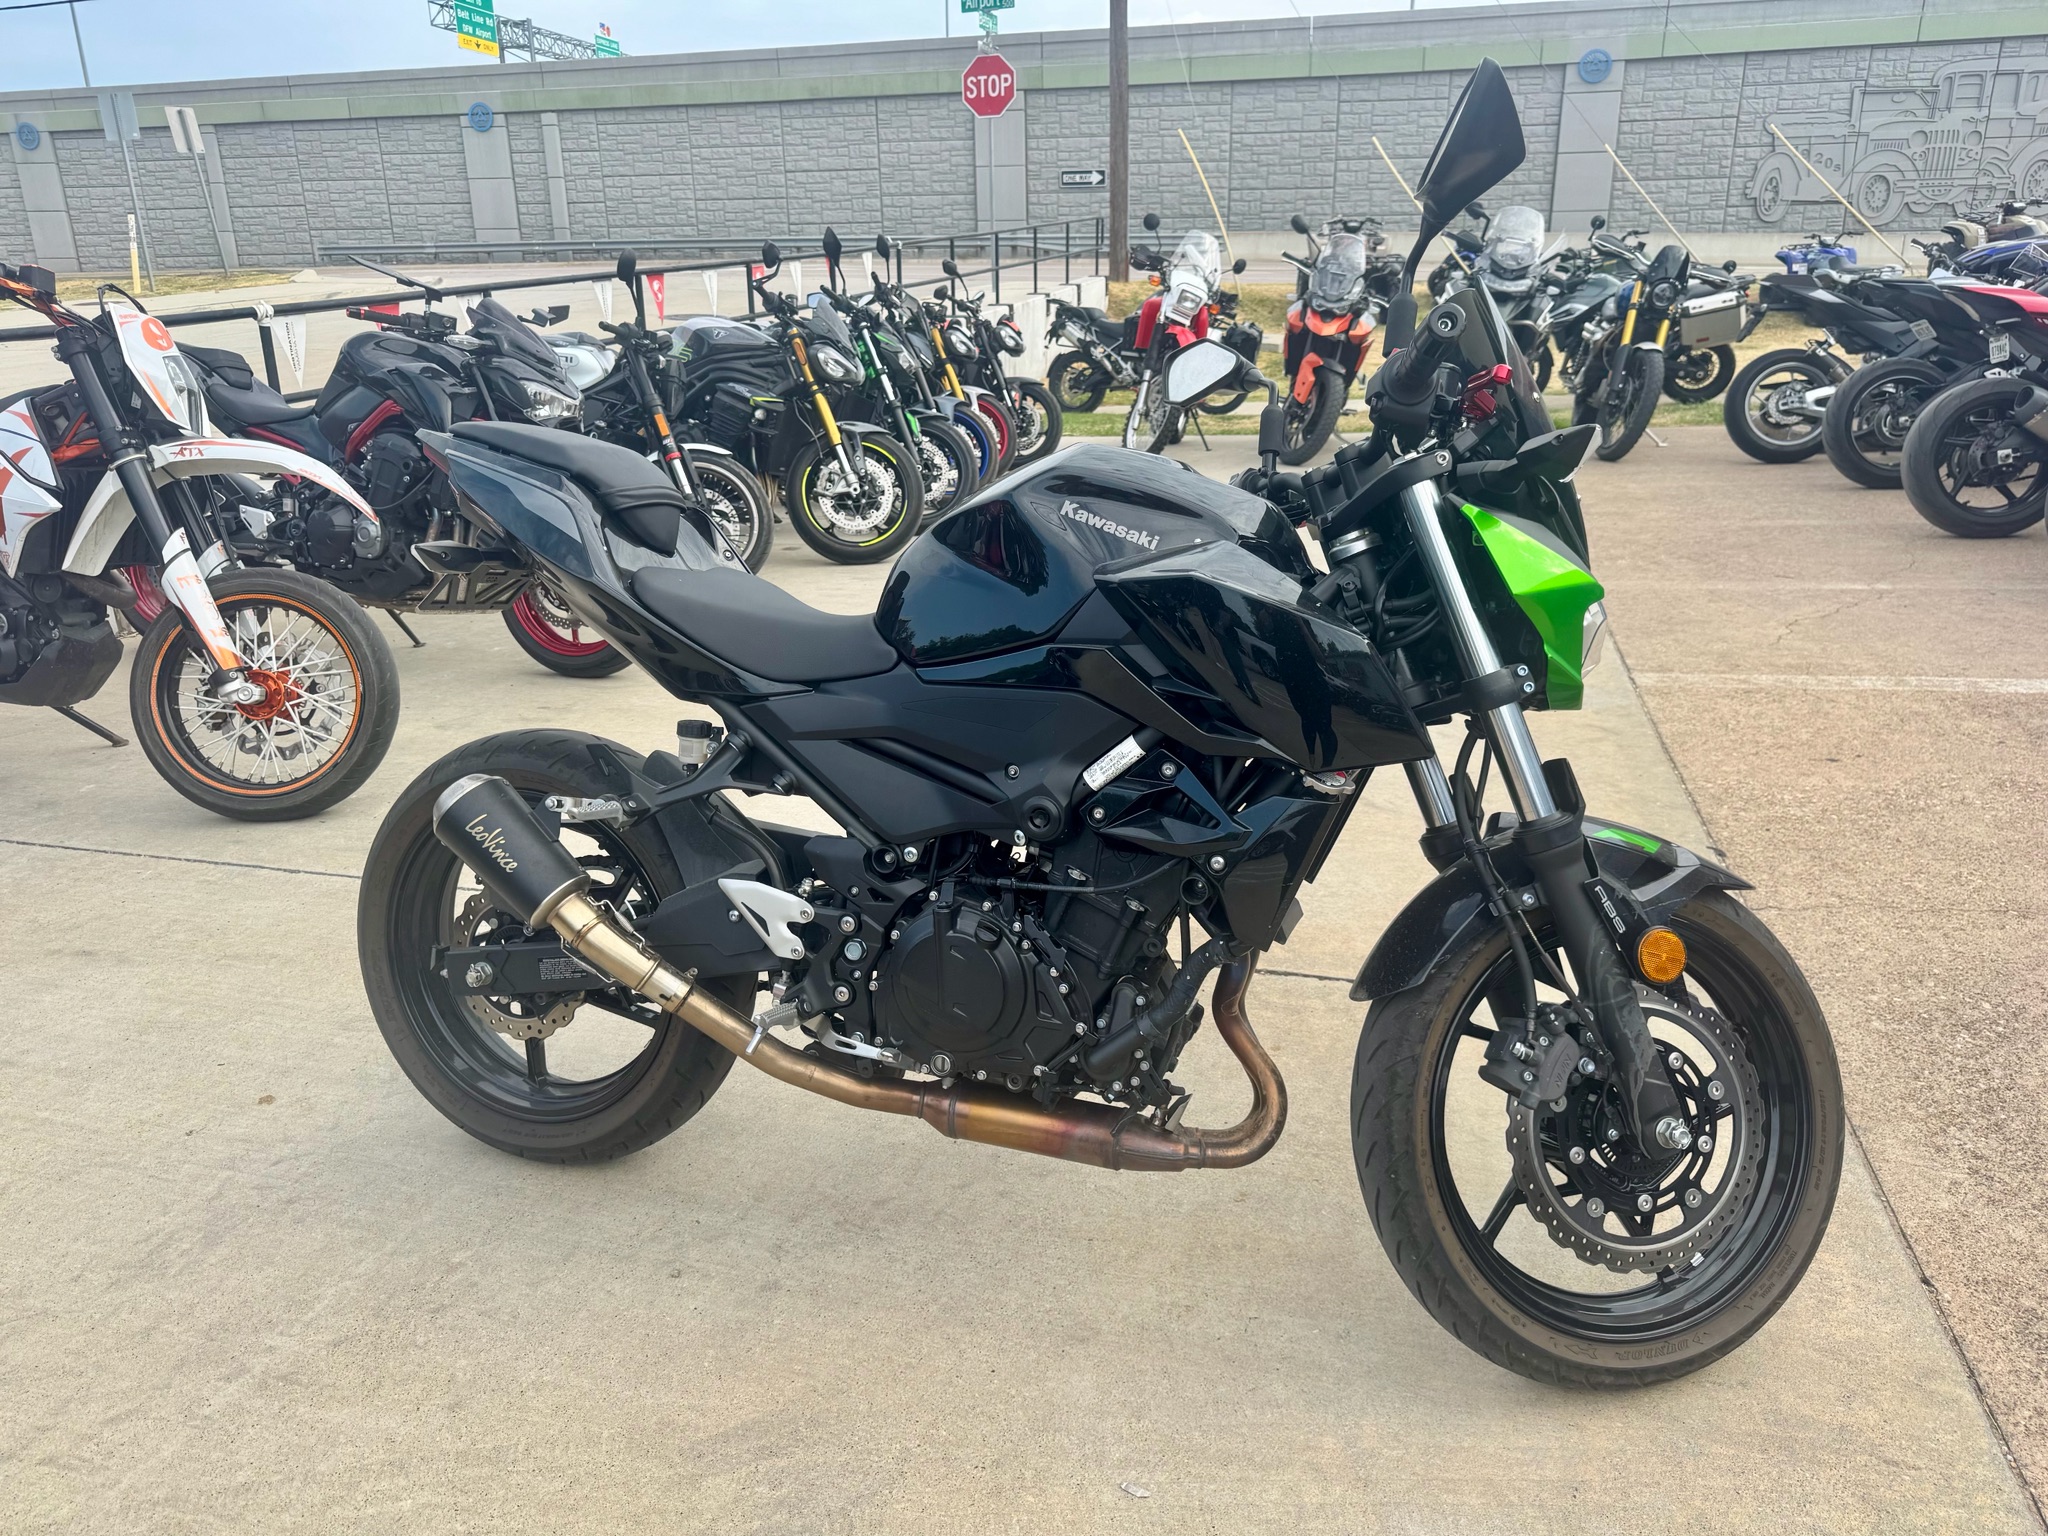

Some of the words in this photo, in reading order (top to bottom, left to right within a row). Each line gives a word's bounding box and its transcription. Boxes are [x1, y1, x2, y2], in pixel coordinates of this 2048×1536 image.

[457, 8, 470, 20] Belt
[471, 13, 484, 24] Line
[485, 17, 493, 27] Rd
[462, 24, 473, 34] DFW
[475, 28, 492, 39] Airport
[463, 38, 472, 46] EXIT
[483, 43, 494, 52] ONLY
[966, 74, 1012, 99] STOP
[1060, 500, 1160, 550] Kawasaki
[1595, 885, 1626, 933] ABS
[1615, 1338, 1690, 1361] DUNLOP
